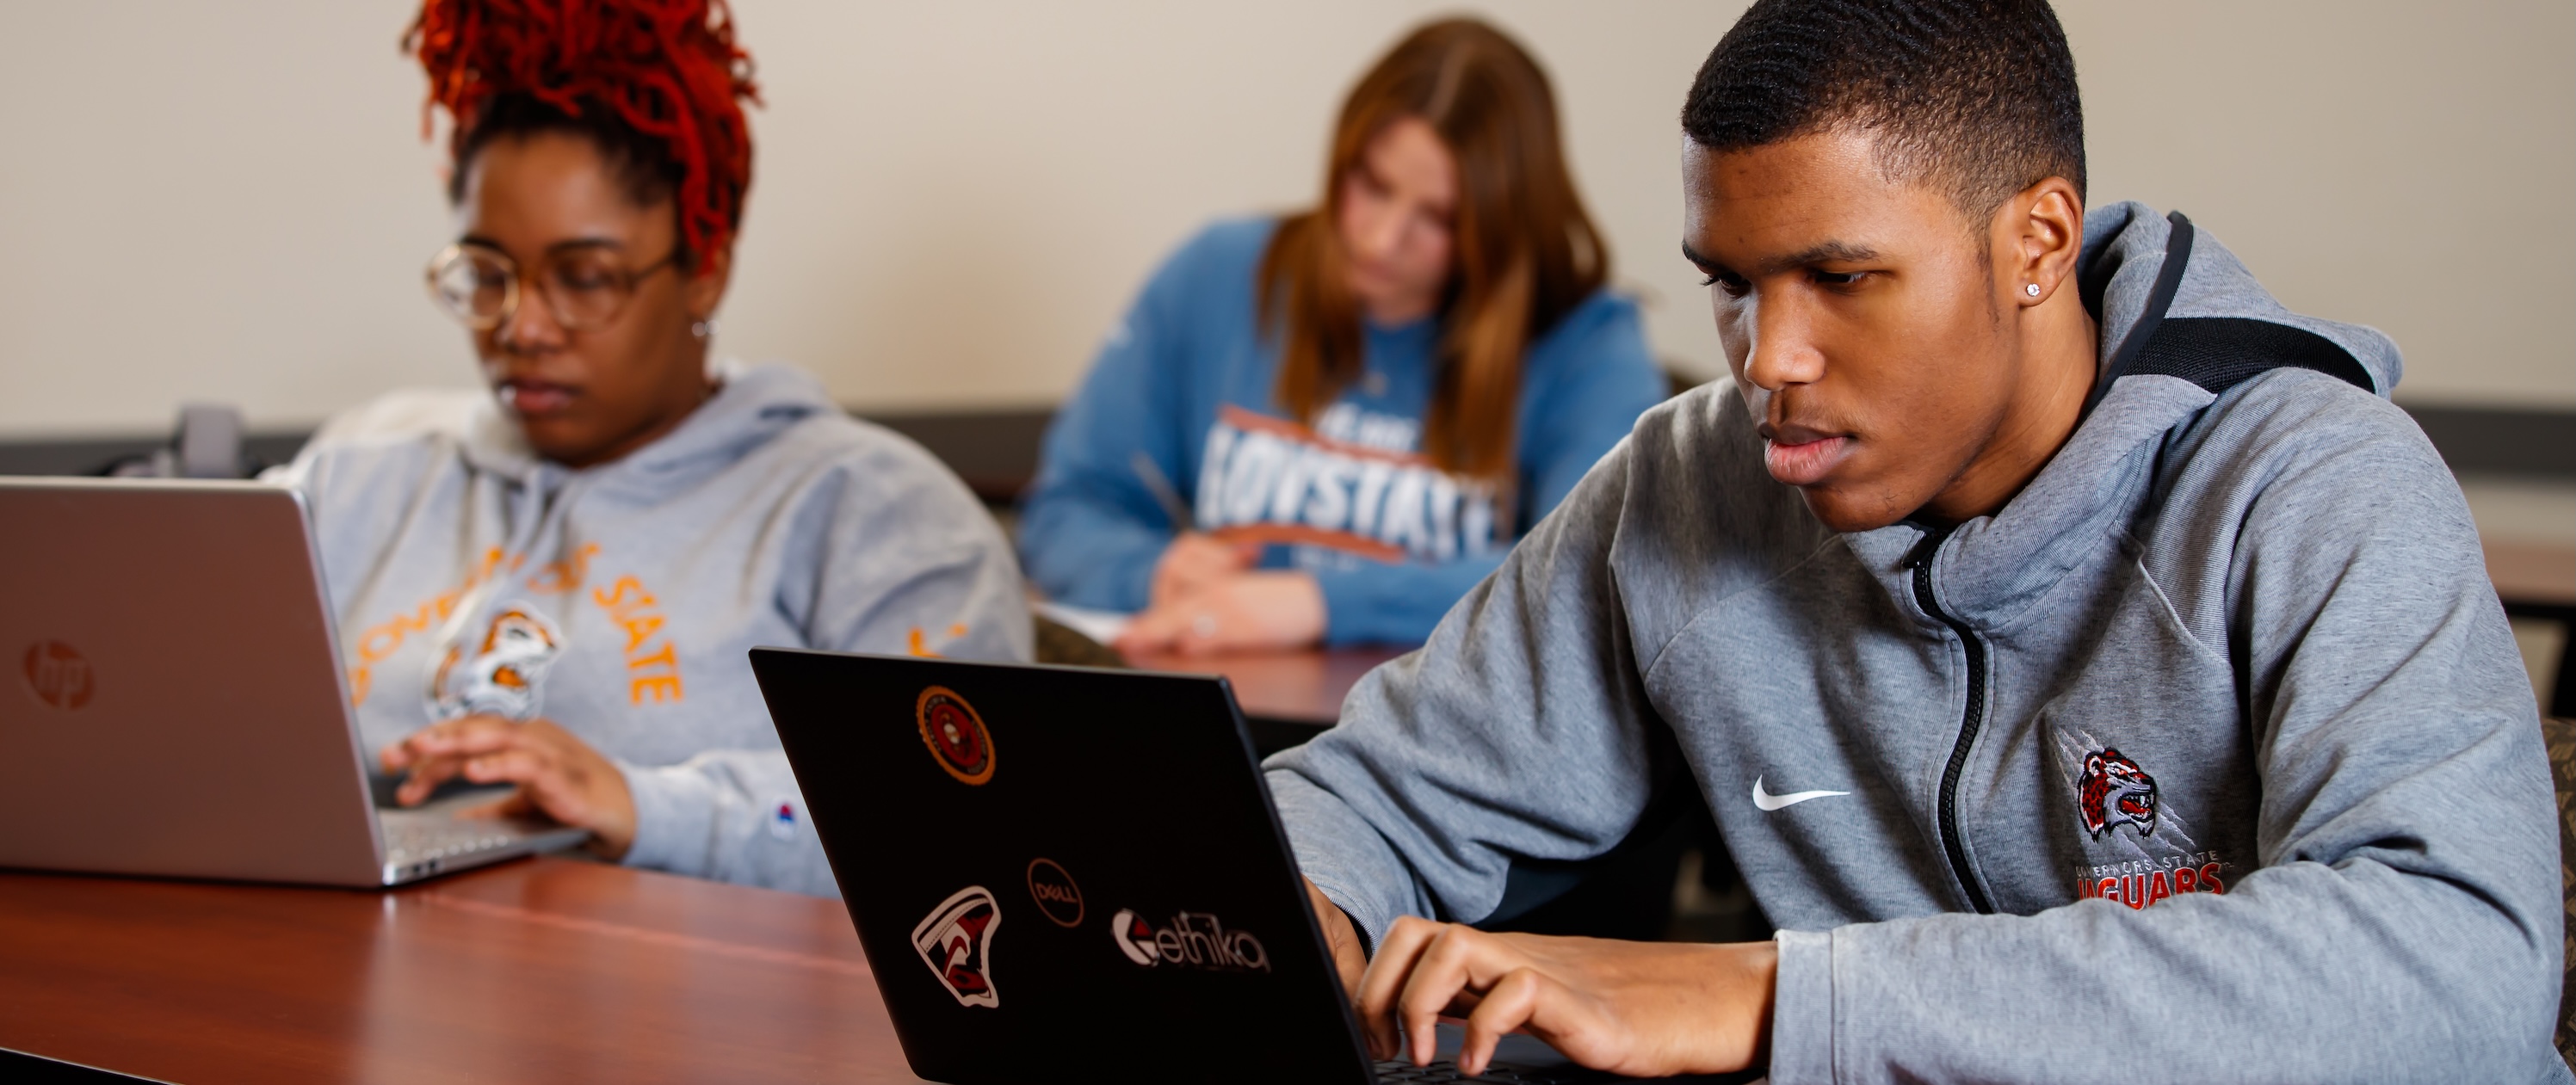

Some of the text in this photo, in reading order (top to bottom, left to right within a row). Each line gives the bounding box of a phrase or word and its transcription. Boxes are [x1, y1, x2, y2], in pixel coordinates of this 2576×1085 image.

[593, 575, 685, 706] STATE
[2075, 849, 2219, 878] GOVERNORS STATE
[1036, 882, 1078, 903] DELL
[1155, 909, 1272, 974] ethika
